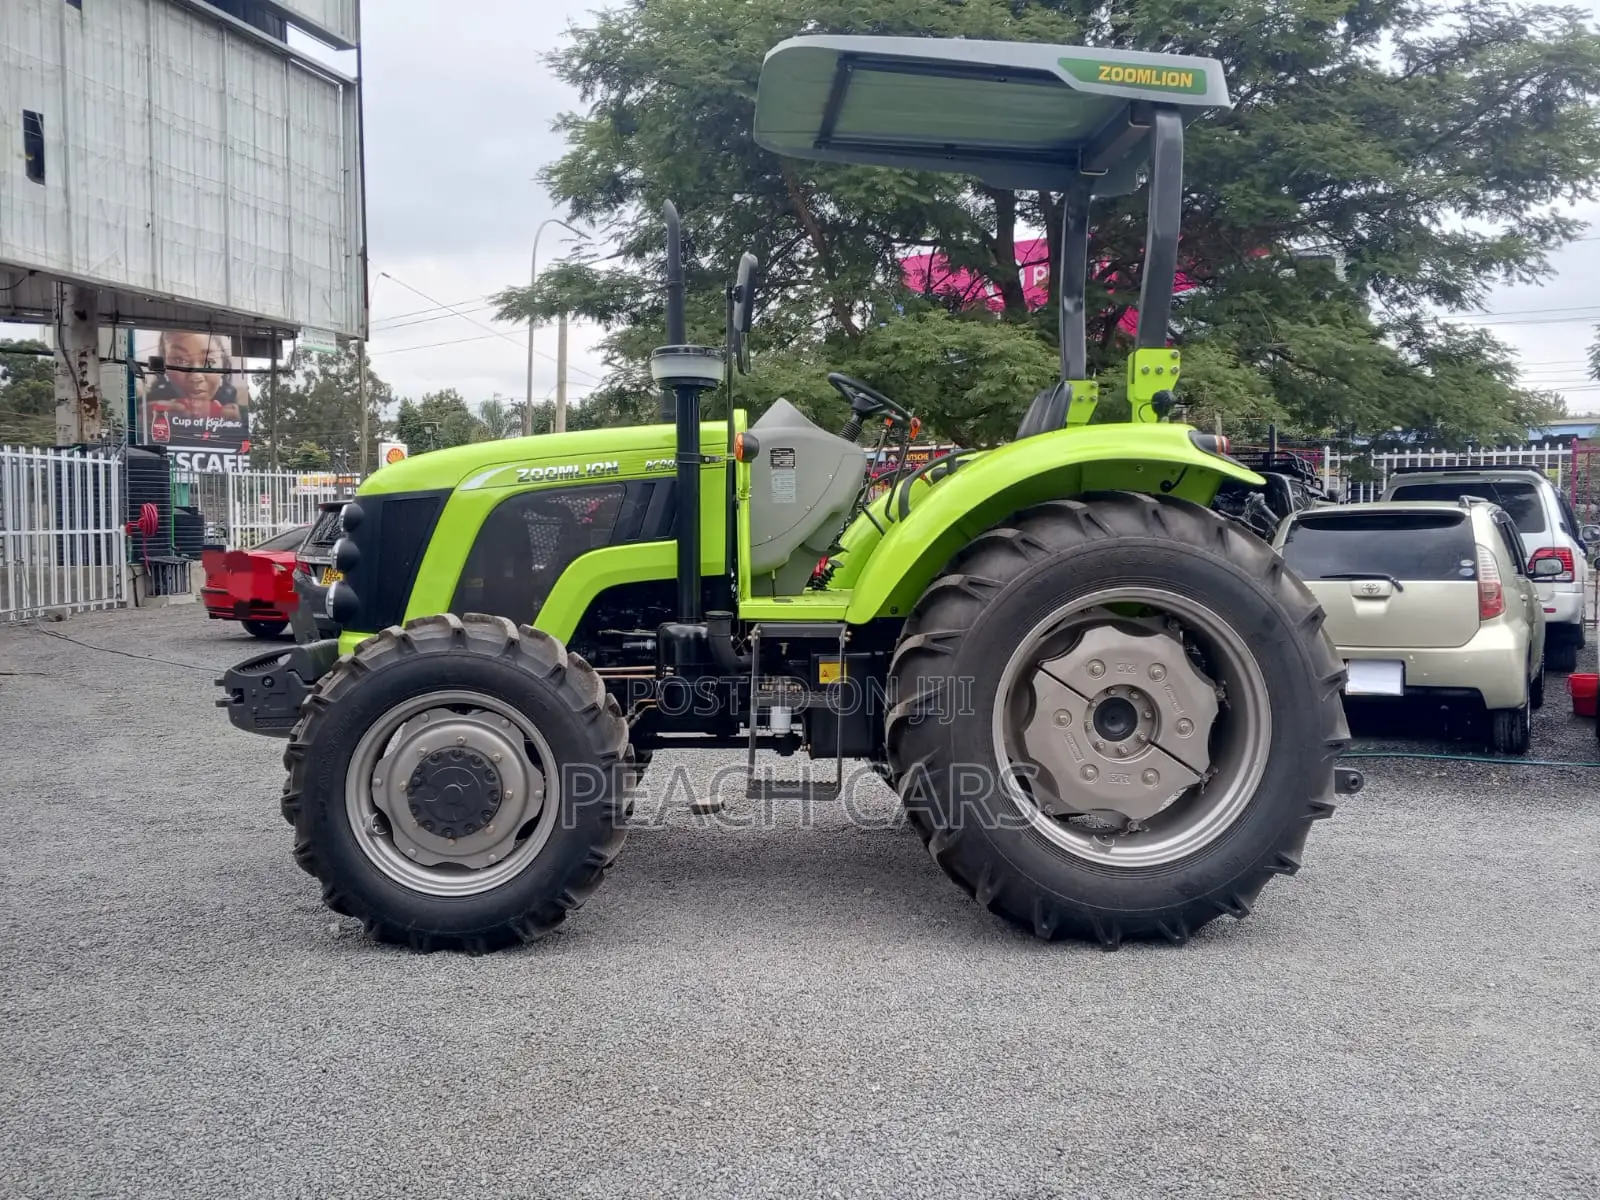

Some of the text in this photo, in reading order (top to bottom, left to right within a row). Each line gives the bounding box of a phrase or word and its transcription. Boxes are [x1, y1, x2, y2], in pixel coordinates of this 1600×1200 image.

[1098, 64, 1193, 88] ZOOMLION
[172, 416, 191, 427] Cup
[193, 417, 203, 426] of
[516, 460, 619, 483] ZOOMLION
[645, 459, 678, 472] RC90
